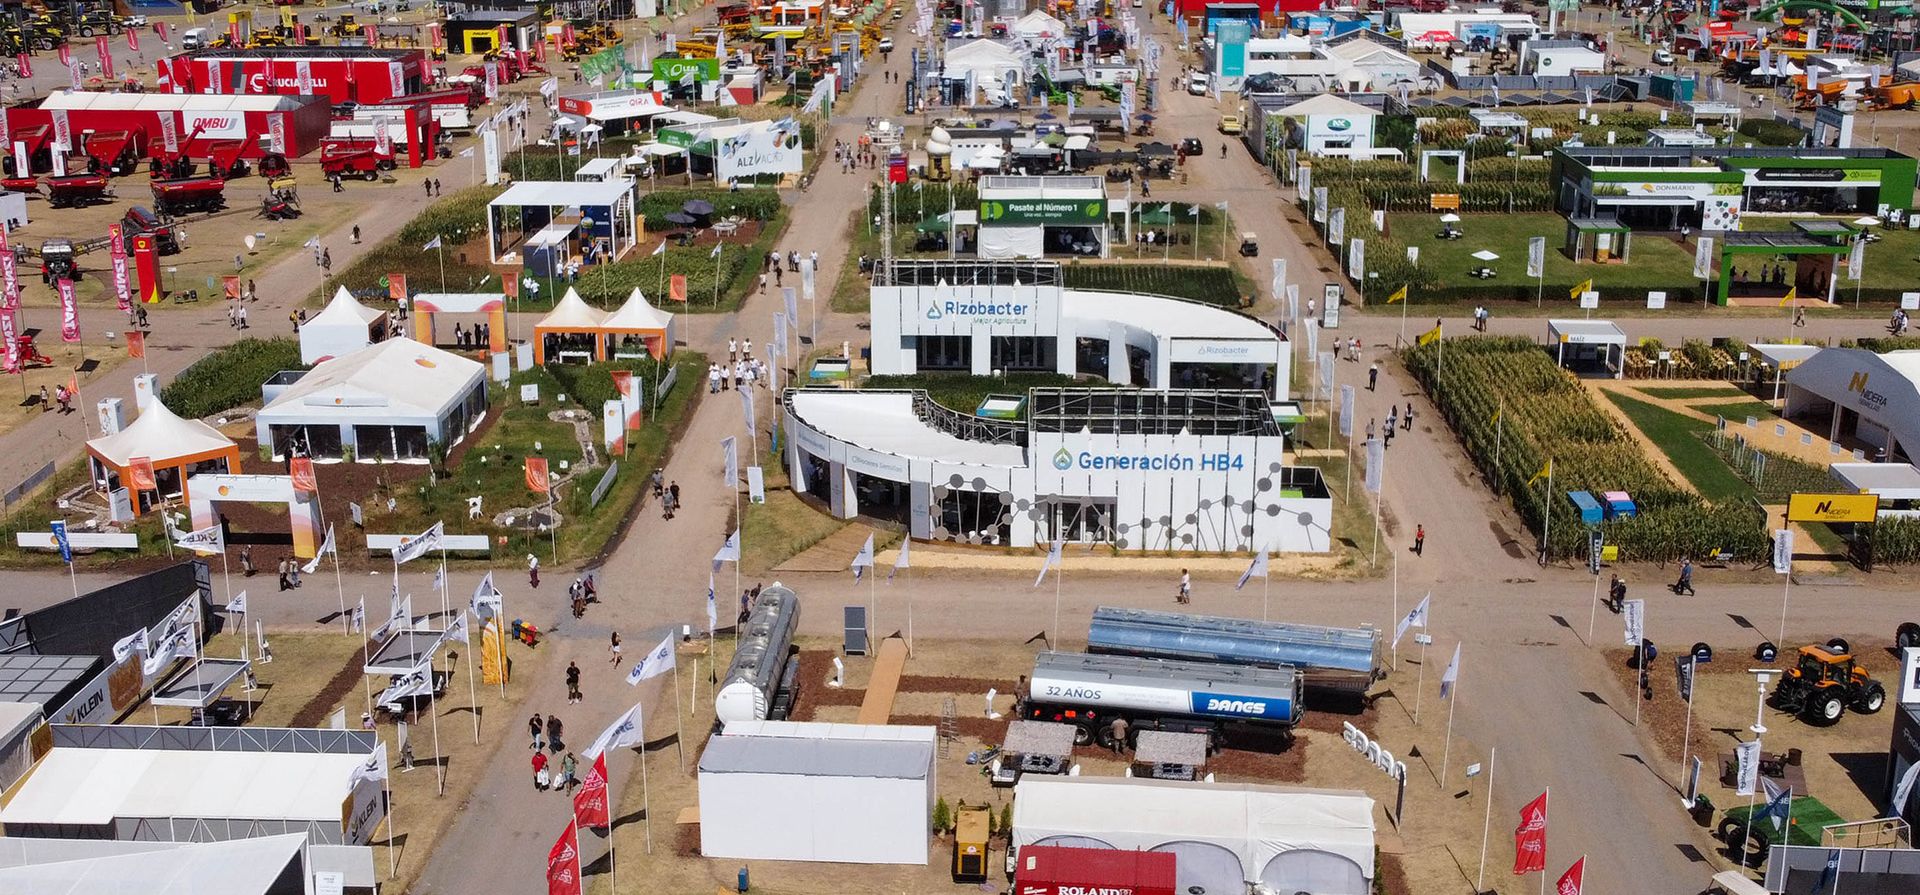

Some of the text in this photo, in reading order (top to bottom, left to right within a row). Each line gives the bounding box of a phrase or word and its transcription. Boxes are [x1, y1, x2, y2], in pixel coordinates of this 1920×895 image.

[192, 117, 230, 129] OMBU
[1009, 204, 1033, 212] Pasate
[1035, 203, 1042, 212] al
[1043, 203, 1073, 212] Número
[945, 301, 1028, 315] Rizobacter
[1206, 346, 1249, 354] Rizobacter
[1860, 389, 1888, 407] NIDERA
[1078, 451, 1245, 472] Generación HB4
[1046, 685, 1102, 700] 32 AÑOS
[77, 688, 104, 722] KLEIN
[358, 796, 377, 826] KLEIN
